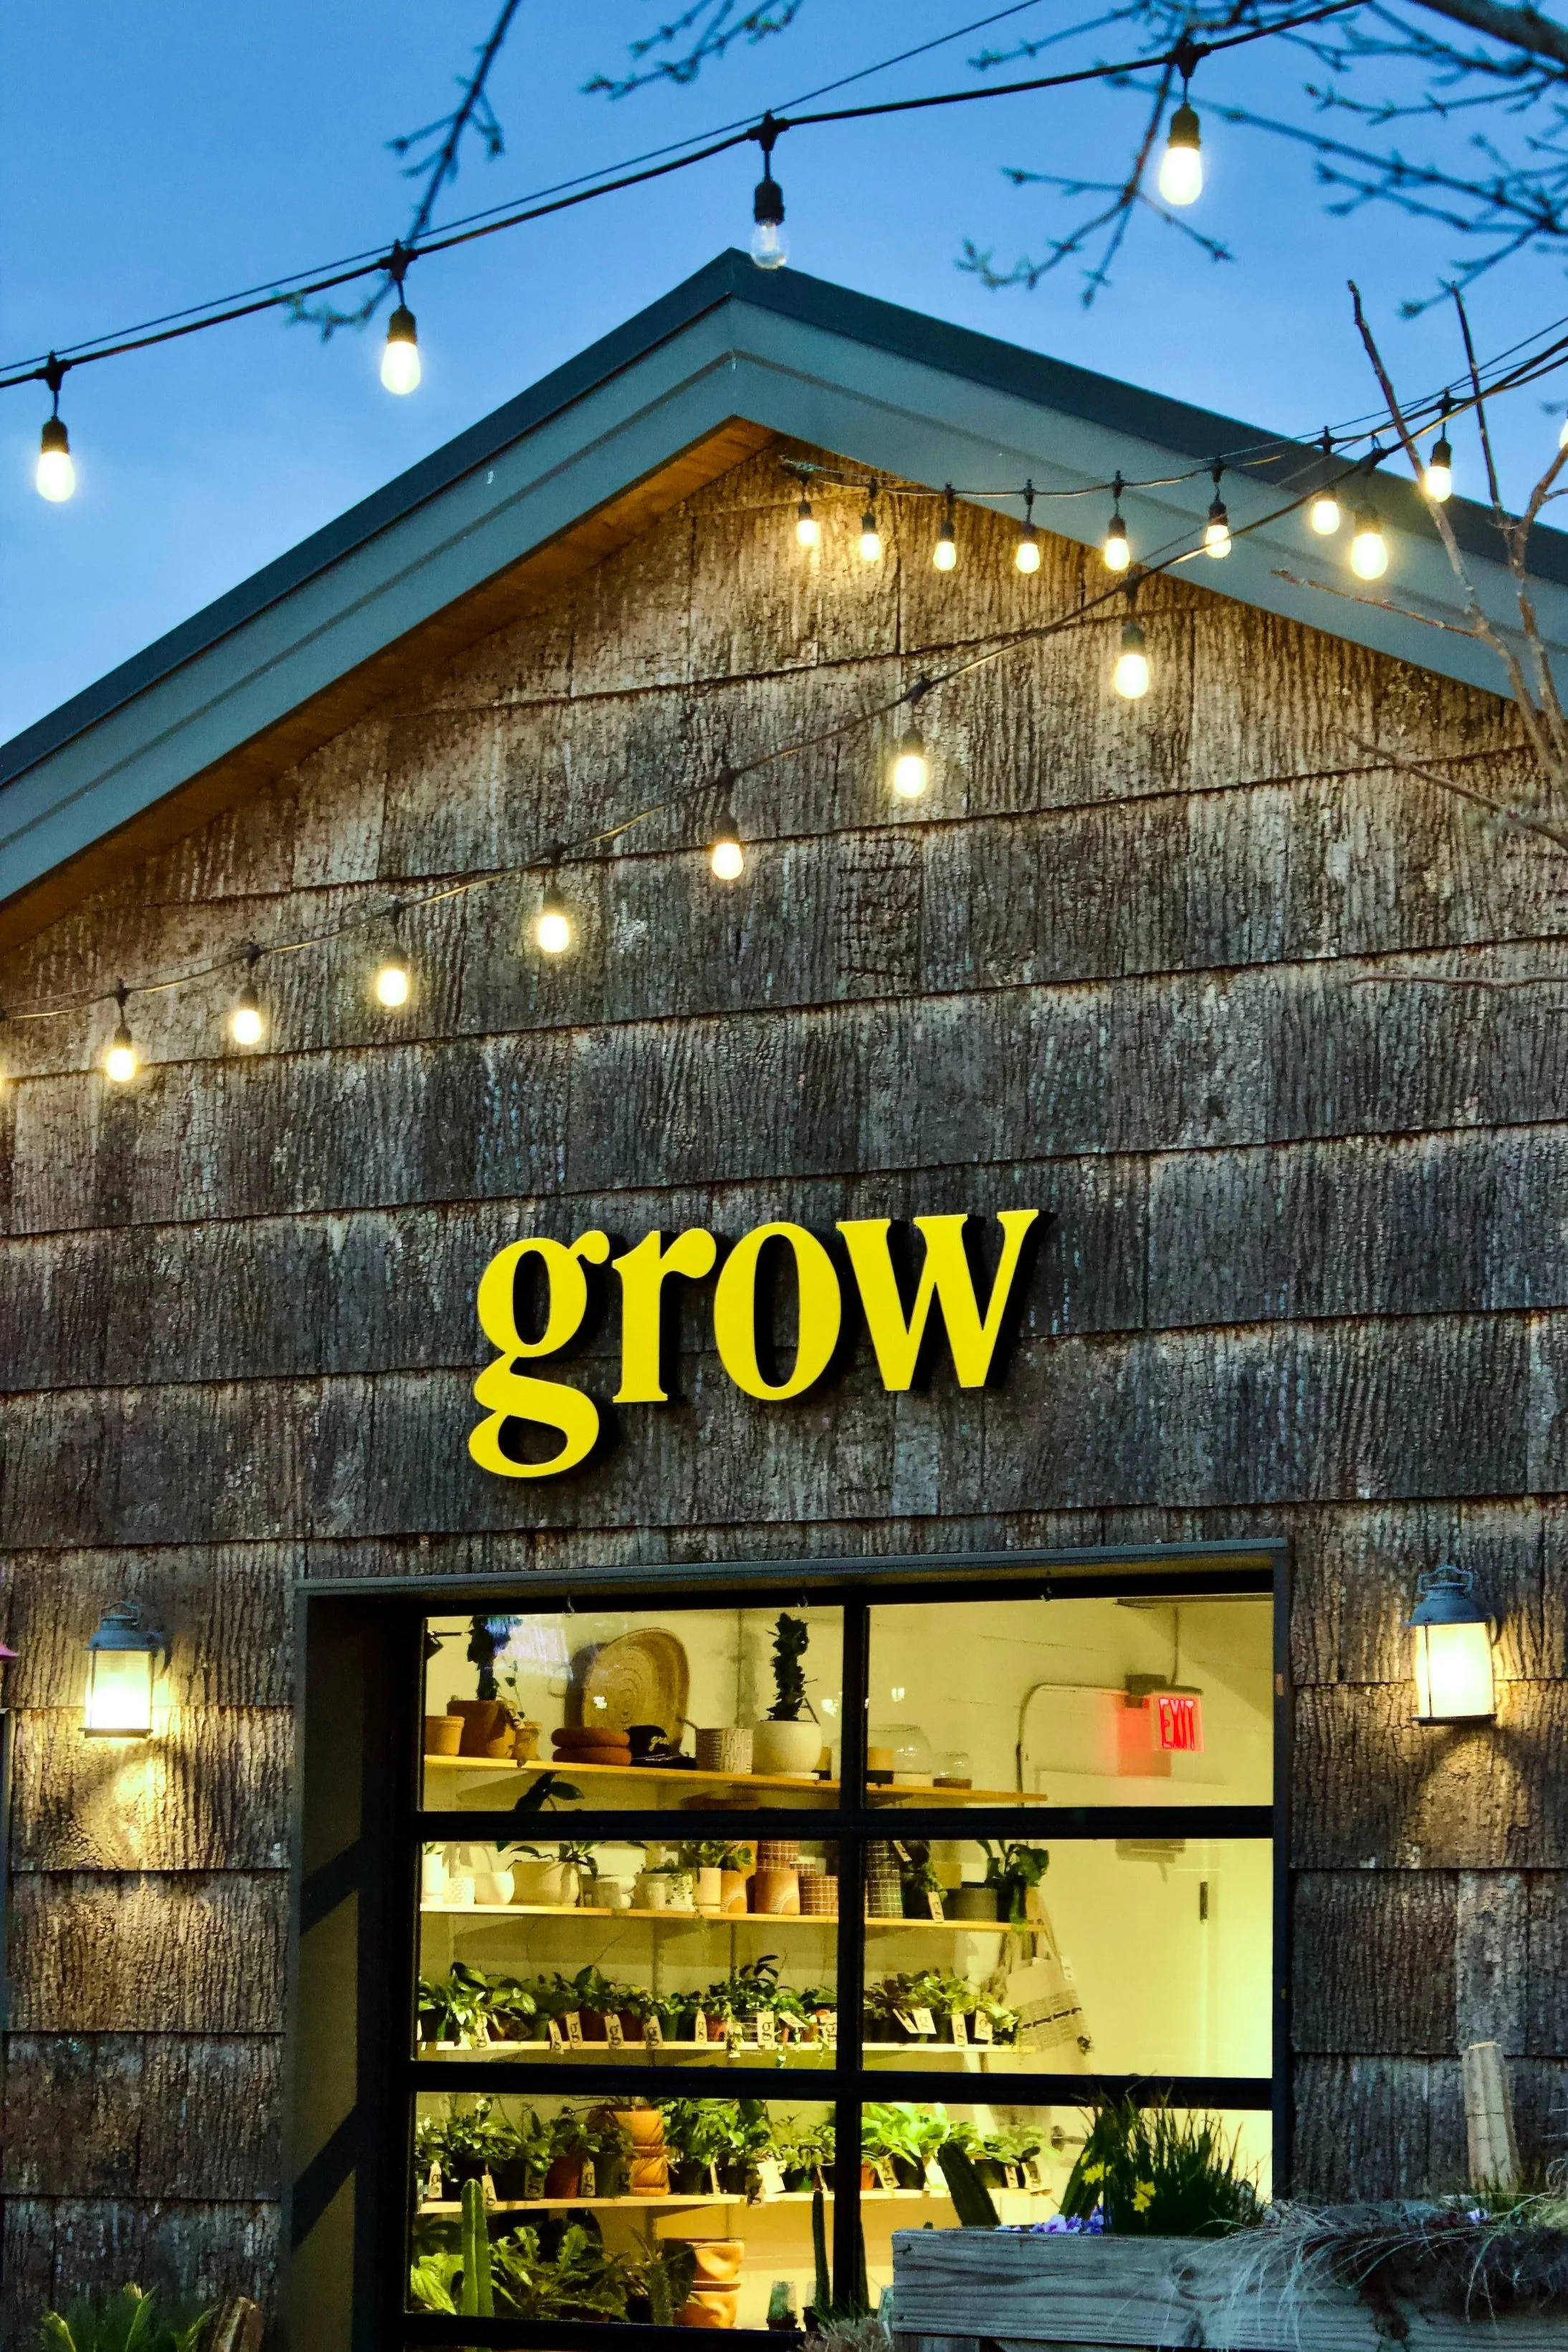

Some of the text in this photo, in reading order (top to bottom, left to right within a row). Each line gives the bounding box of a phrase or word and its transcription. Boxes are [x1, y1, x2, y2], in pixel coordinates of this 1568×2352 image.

[468, 1209, 1039, 1478] grow
[1159, 1698, 1195, 1750] EXIT
[570, 2022, 580, 2044] g
[609, 2024, 621, 2045] g
[646, 2027, 659, 2047] g
[762, 2022, 773, 2042] g
[584, 2172, 593, 2193] g
